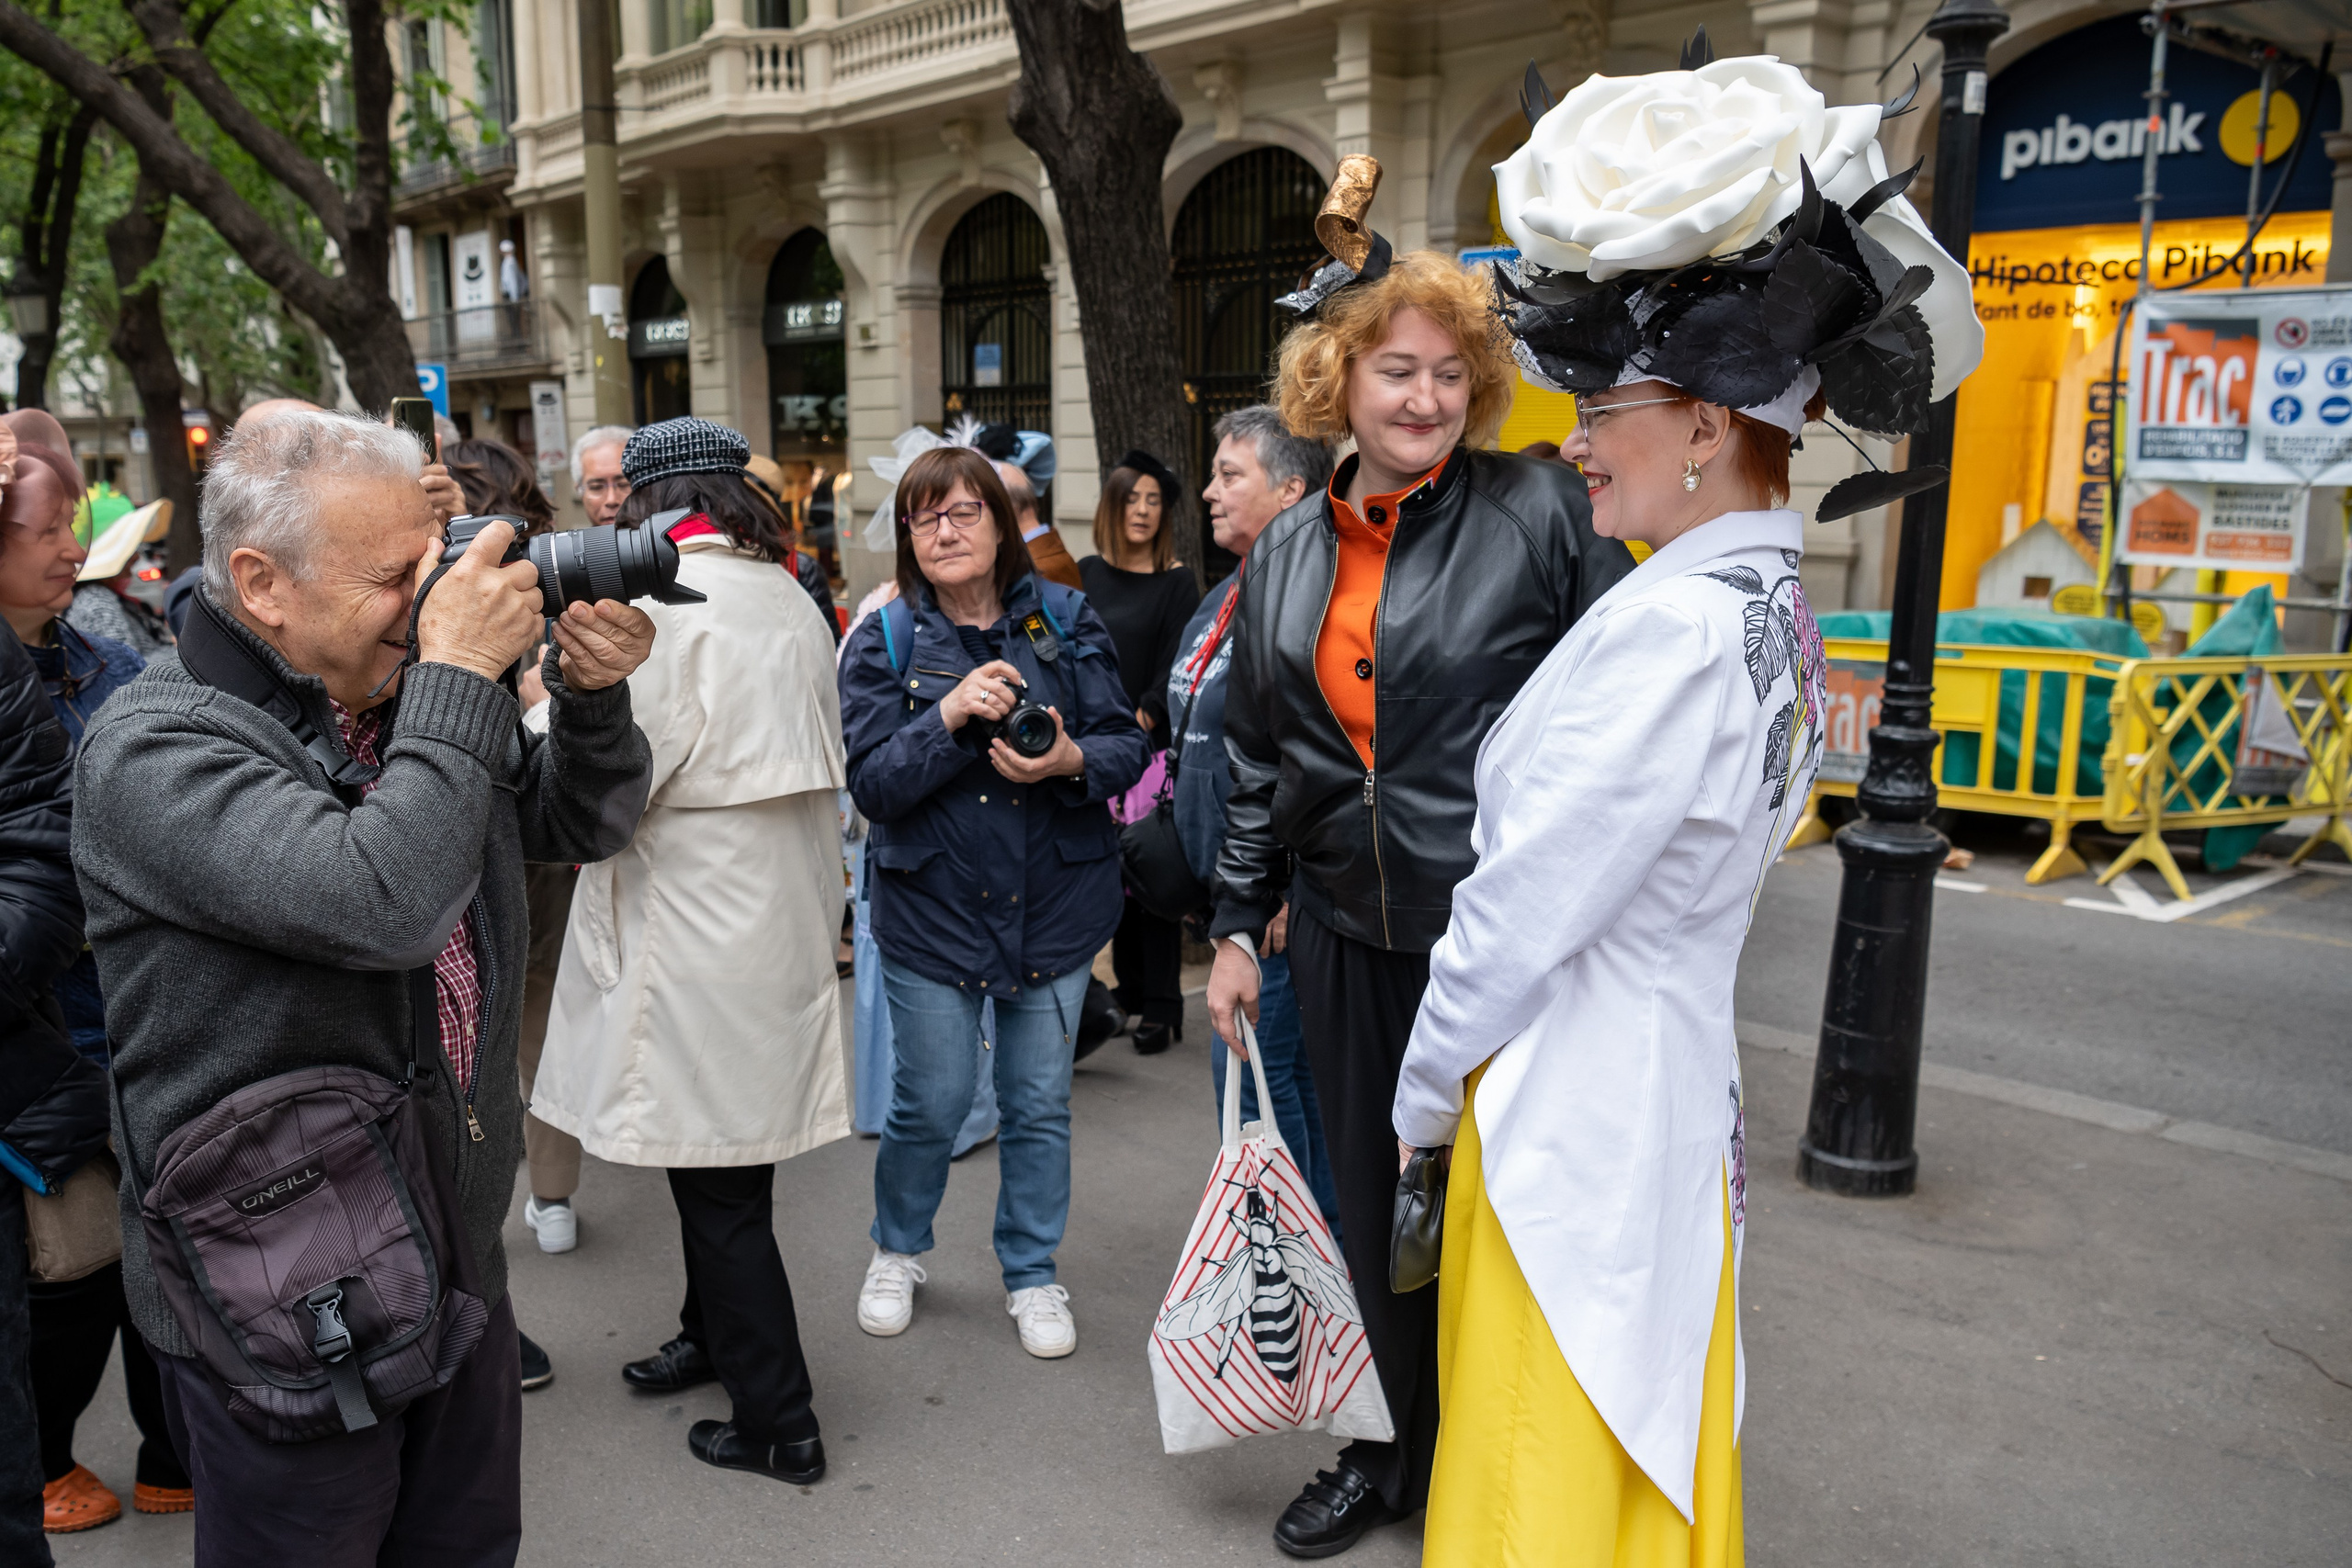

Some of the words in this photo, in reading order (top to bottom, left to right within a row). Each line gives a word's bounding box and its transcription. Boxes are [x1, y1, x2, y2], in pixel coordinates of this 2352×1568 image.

[2164, 240, 2315, 278] Pibank
[2027, 299, 2056, 319] de
[2143, 339, 2246, 427] Trac
[242, 1168, 321, 1210] O'NEILL
